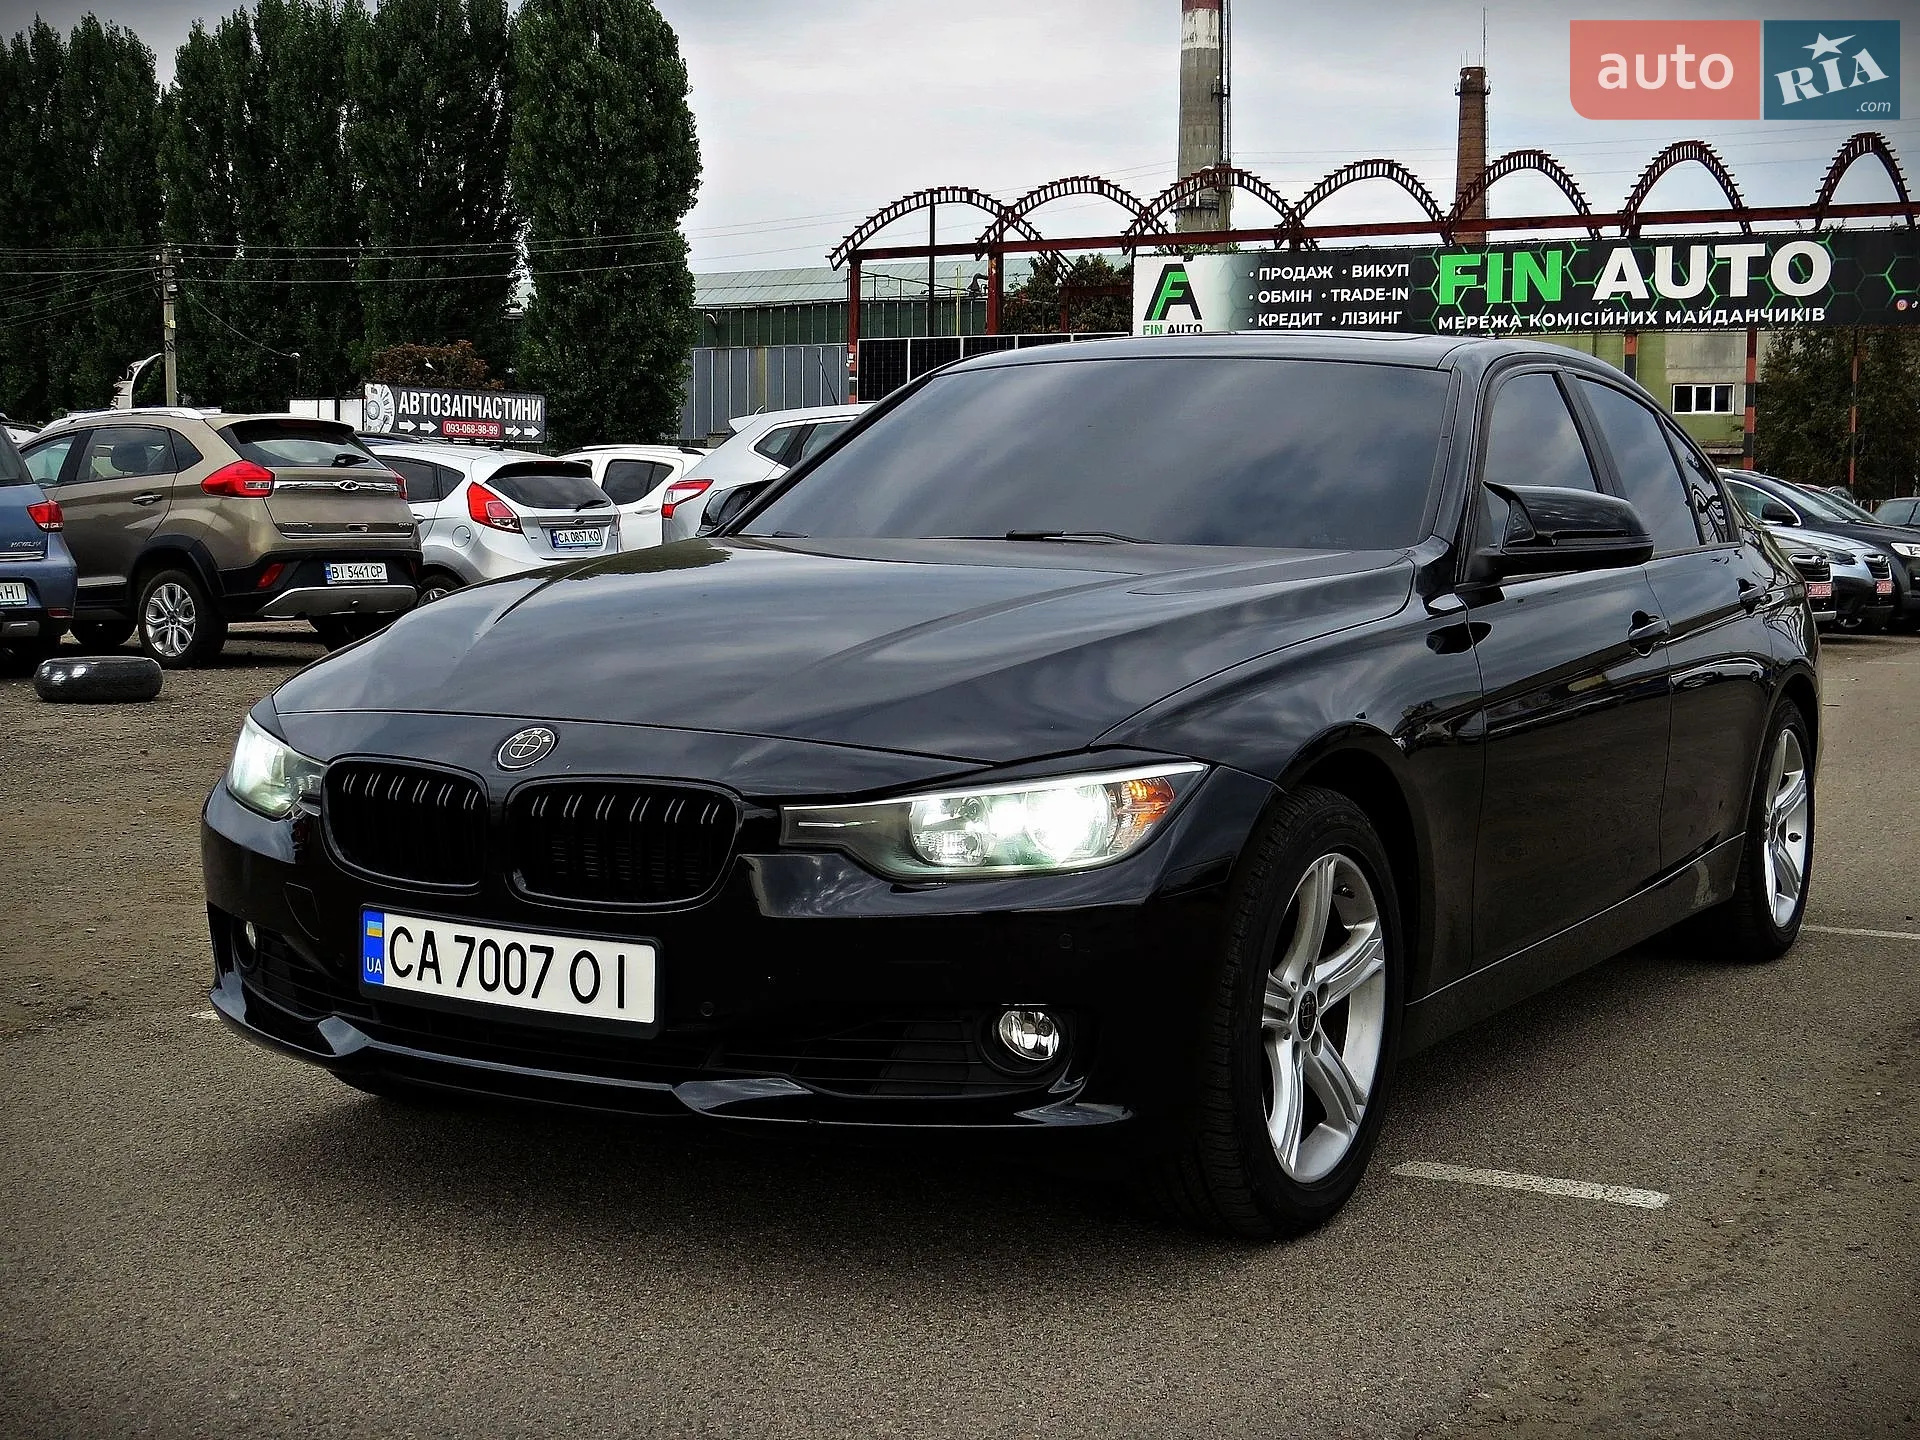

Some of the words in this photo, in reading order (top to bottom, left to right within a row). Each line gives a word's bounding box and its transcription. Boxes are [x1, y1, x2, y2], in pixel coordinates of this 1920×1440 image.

[1259, 265, 1333, 282] ПРОДАЖ
[1351, 263, 1410, 279] ВИКУП
[1438, 249, 1563, 305] FIN
[1591, 240, 1832, 301] AUTO
[1257, 289, 1313, 304] ОБМІН
[1331, 287, 1410, 303] TRADE-IN
[1257, 312, 1323, 328] КРЕДИТ
[1340, 310, 1403, 326] ЛІЗИНГ
[1438, 313, 1523, 331] МЕРЕЖА
[1529, 307, 1659, 328] КОМІСІЙНИХ
[1665, 306, 1826, 327] МАЙДАНЧИКІВ
[1142, 324, 1164, 336] FIN
[1167, 323, 1203, 335] AUTO
[398, 391, 543, 422] АВТОЗАПЧАСТИНИ
[445, 423, 499, 436] 093-068-98-99
[366, 957, 383, 975] UA
[389, 925, 443, 985] CA
[453, 934, 555, 999] 7007
